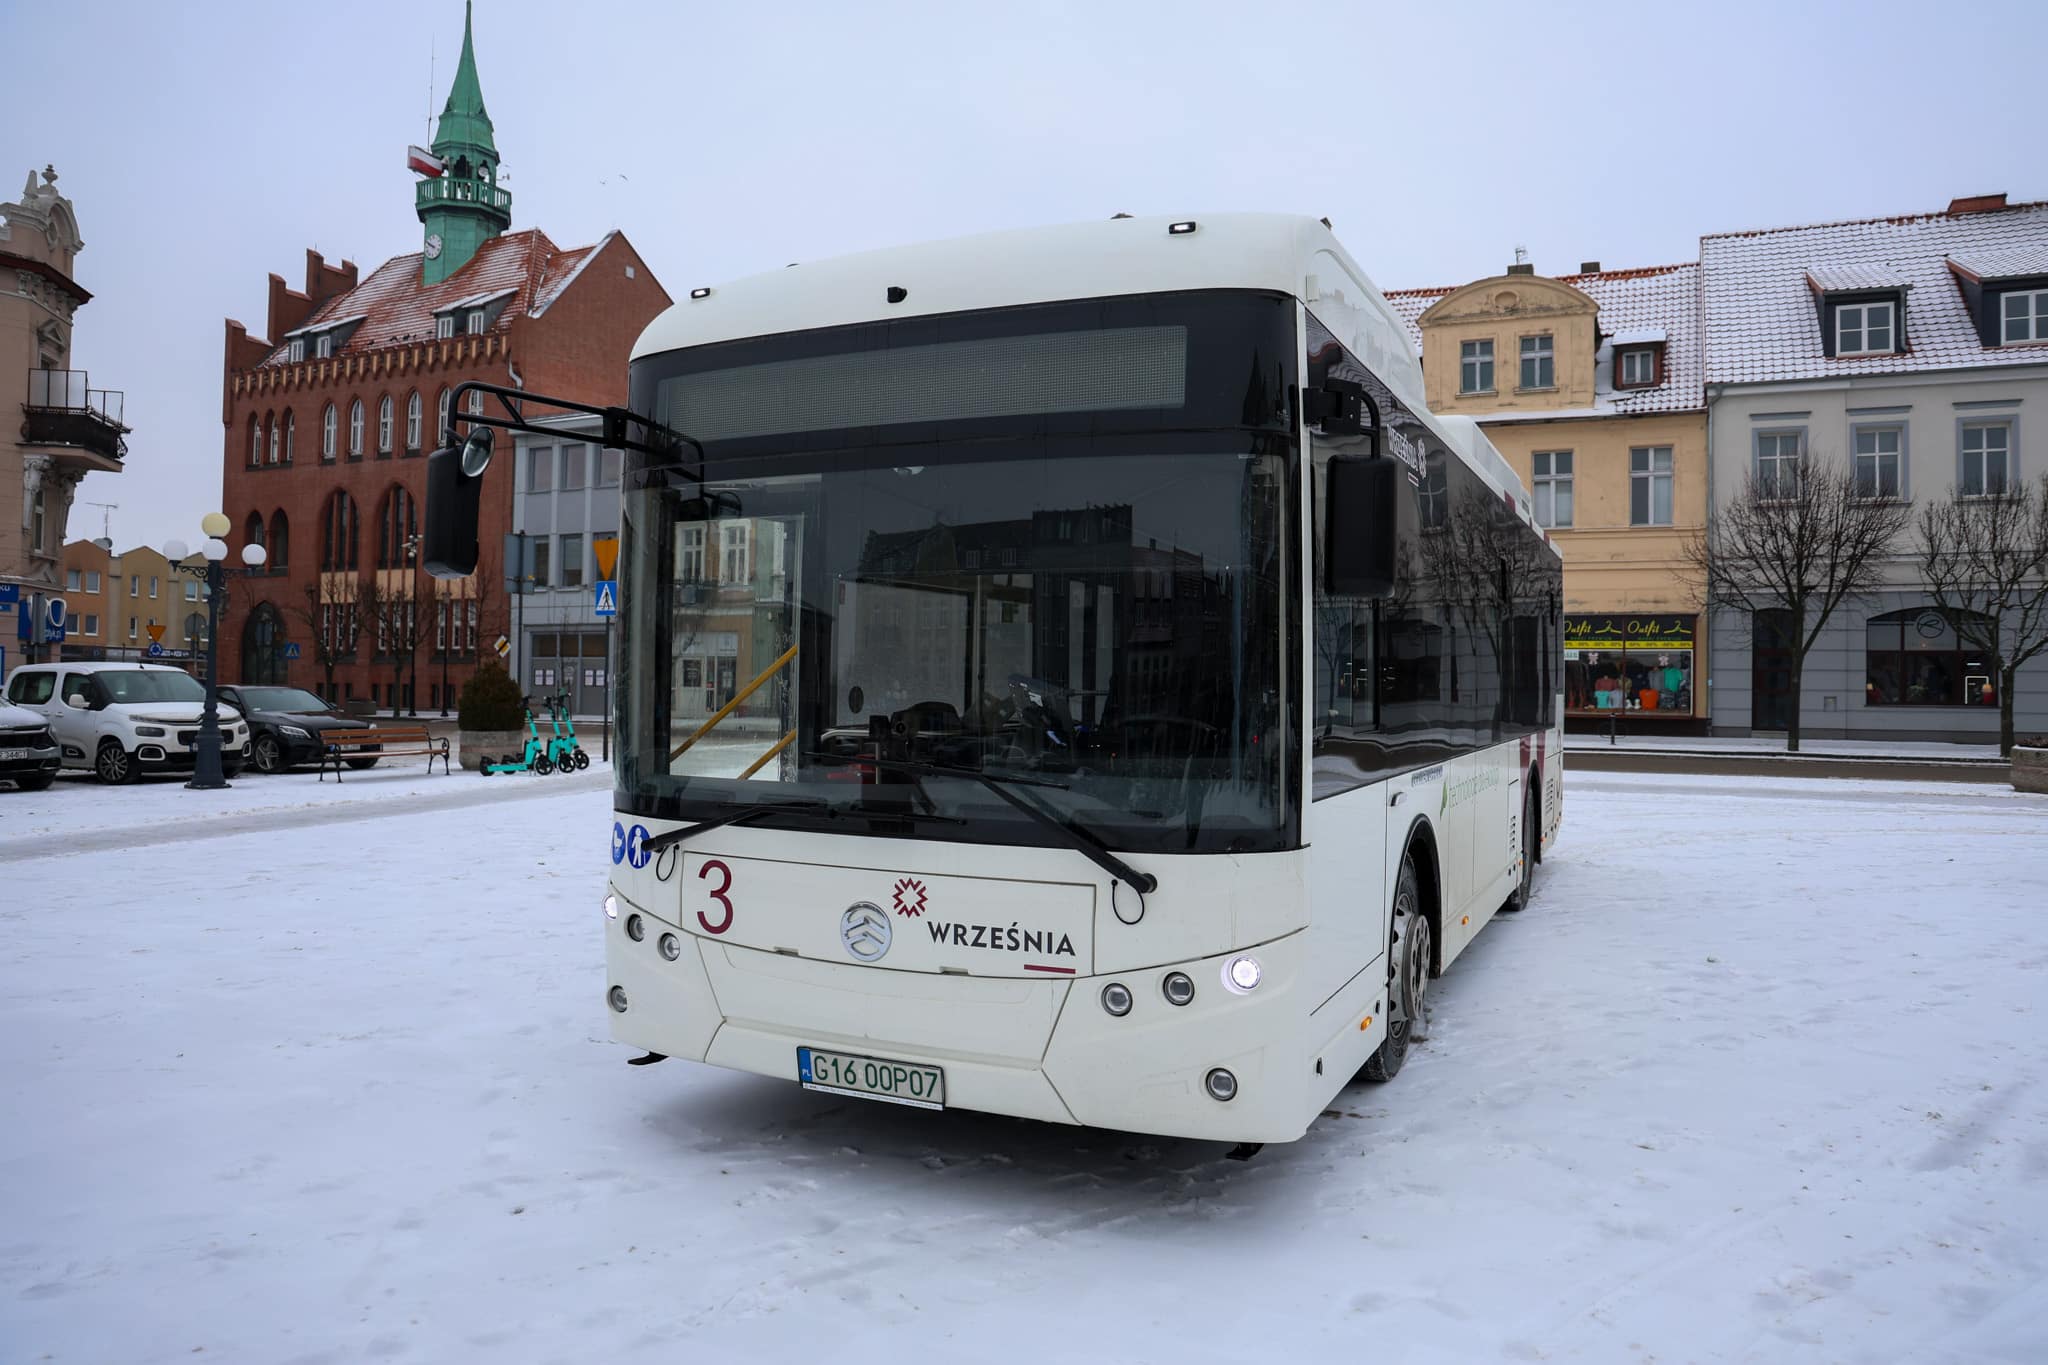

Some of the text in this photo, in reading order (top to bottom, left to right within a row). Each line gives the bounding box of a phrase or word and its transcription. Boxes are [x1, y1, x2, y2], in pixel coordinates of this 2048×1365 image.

[1628, 620, 1660, 636] Outfit
[697, 860, 733, 934] 3
[927, 921, 1076, 956] WRZEŚNIA
[802, 1069, 811, 1077] PL
[814, 1056, 857, 1085] G16
[865, 1063, 938, 1098] 00P07
